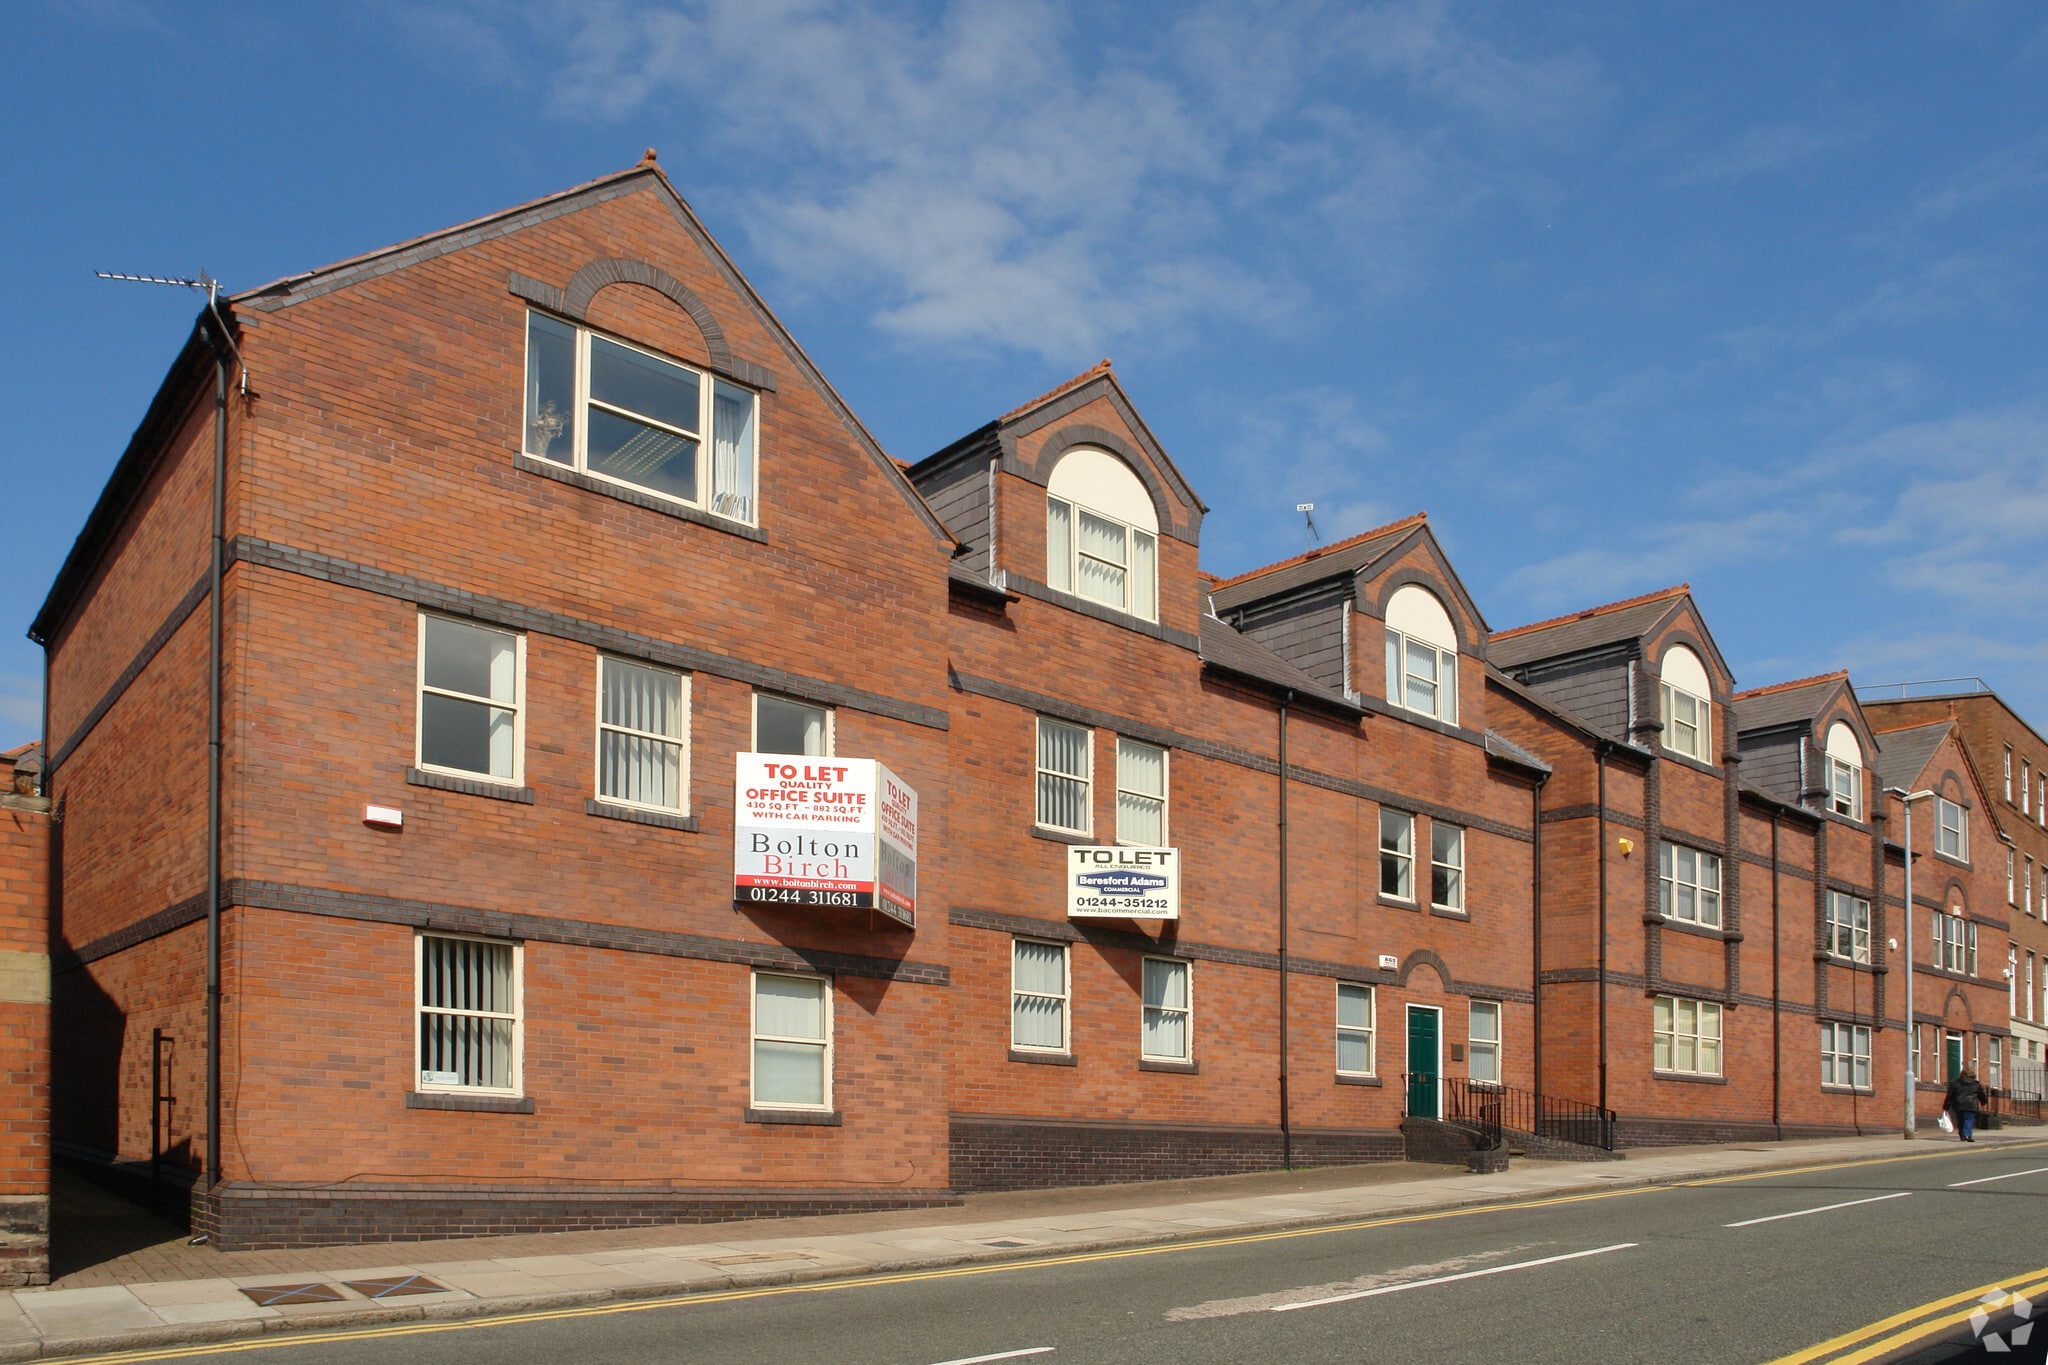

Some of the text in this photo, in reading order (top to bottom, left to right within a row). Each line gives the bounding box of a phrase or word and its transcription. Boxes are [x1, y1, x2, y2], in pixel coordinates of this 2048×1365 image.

[764, 763, 848, 782] TO LET
[780, 781, 832, 790] QUALITY
[746, 788, 866, 805] OFFICE SUITE
[887, 779, 911, 810] TO LET
[752, 811, 860, 823] WITH CAR PARKING
[751, 834, 859, 858] Bolton
[1074, 850, 1171, 865] TO LET
[764, 855, 848, 878] Birch
[753, 878, 857, 890] www.boltonbirch.com
[1079, 876, 1165, 886] Beresford Adams
[751, 887, 858, 906] 01244 311681
[1077, 897, 1168, 908] 01244-351212
[1076, 907, 1168, 915] www.bacommercial.com
